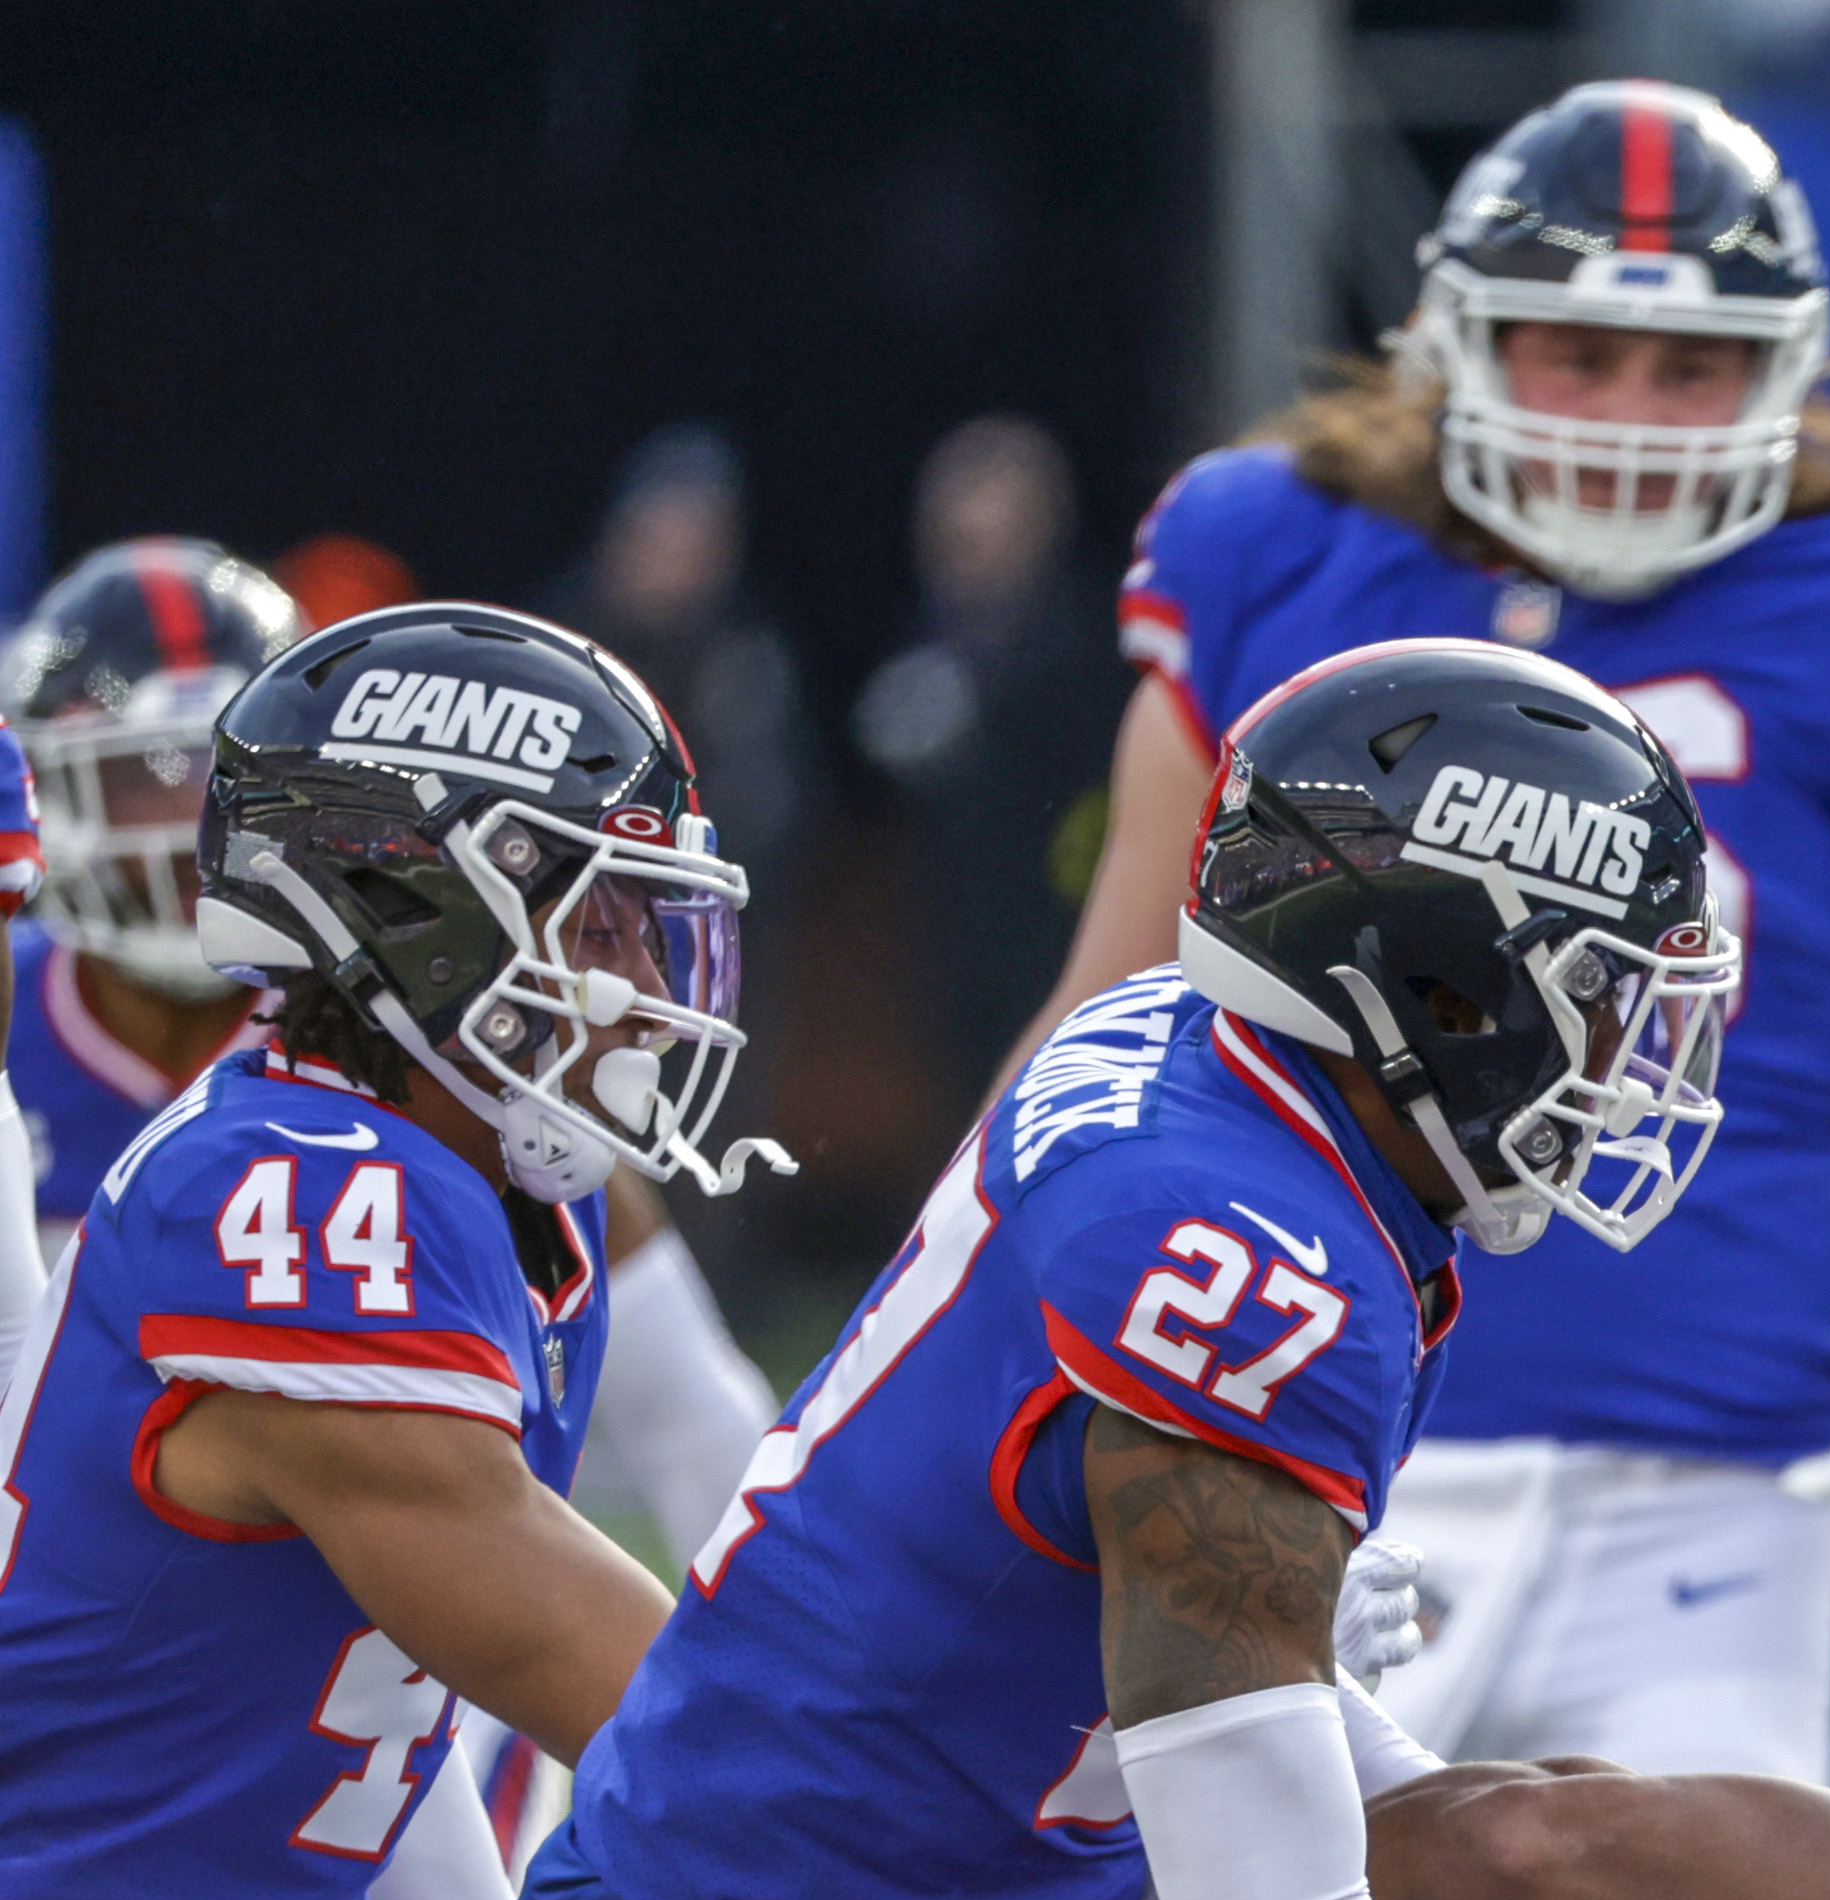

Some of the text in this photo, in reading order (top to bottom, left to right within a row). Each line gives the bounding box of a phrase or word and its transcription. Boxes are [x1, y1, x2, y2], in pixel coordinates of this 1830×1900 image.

[331, 668, 582, 771] GIANTS
[1411, 763, 1651, 897] GIANTS
[213, 1155, 415, 1317] 44
[1111, 1216, 1351, 1424] 27
